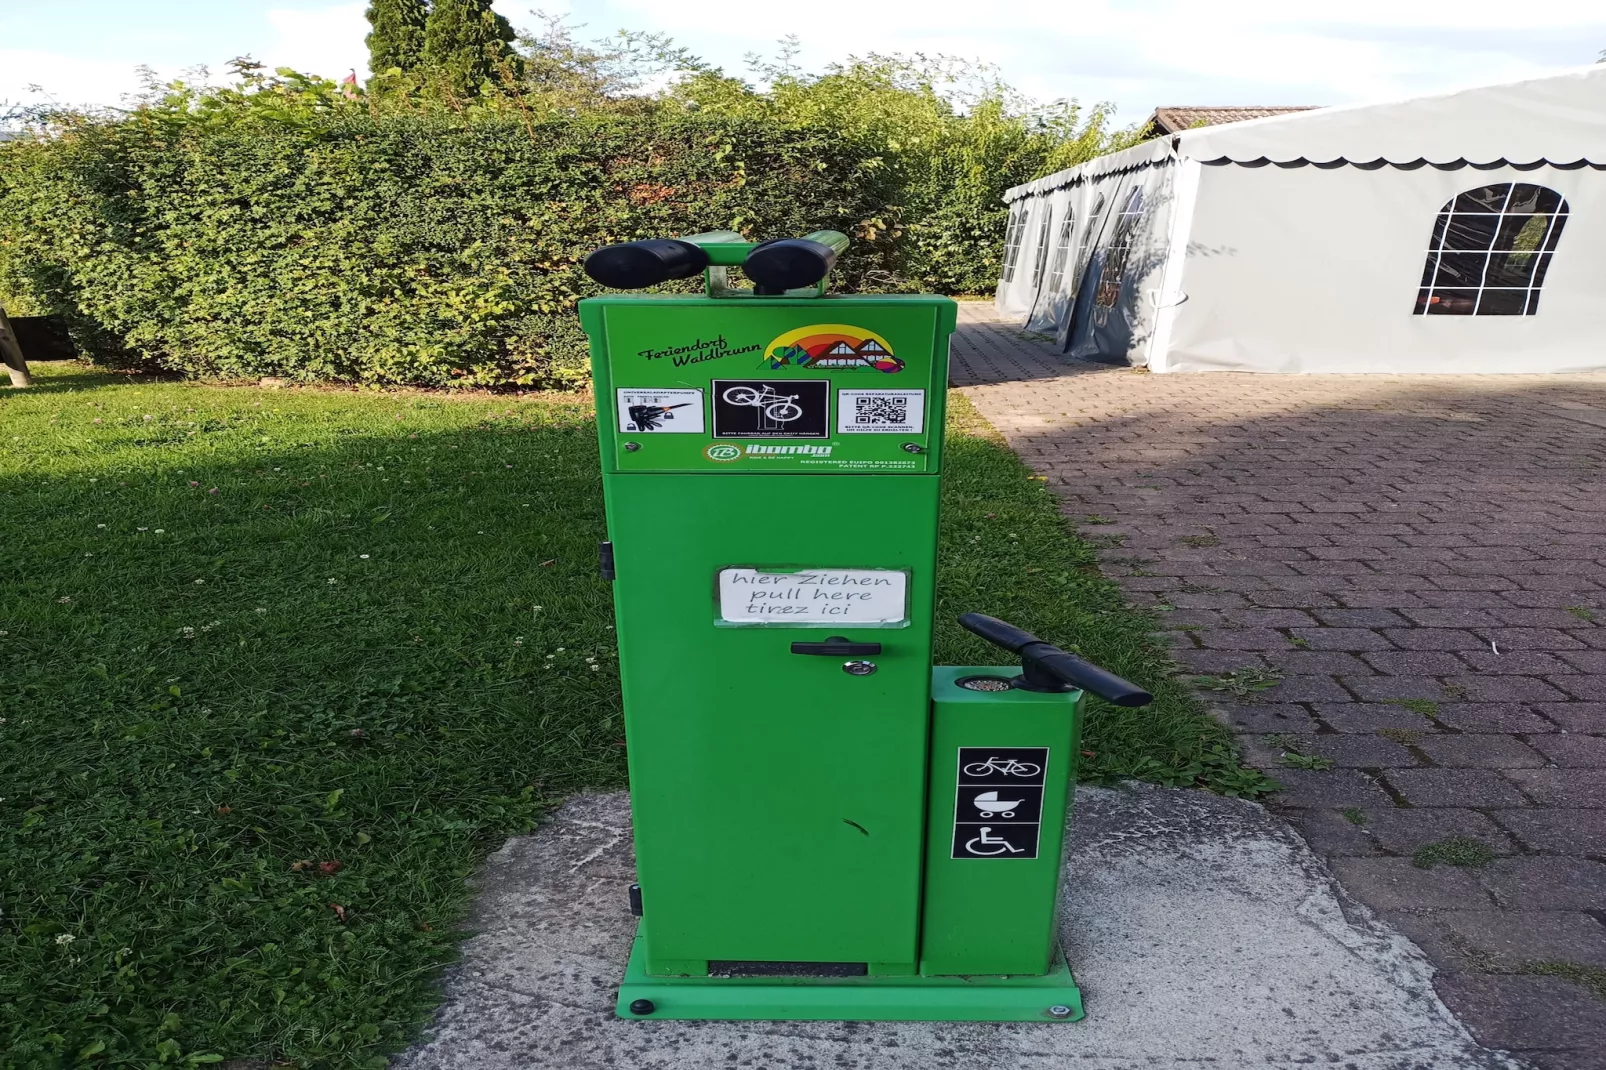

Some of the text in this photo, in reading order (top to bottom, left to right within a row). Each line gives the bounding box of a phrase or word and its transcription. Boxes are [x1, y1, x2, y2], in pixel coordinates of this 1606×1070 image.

[638, 334, 728, 361] Feriendorf
[672, 344, 762, 368] Waldbrunn
[732, 573, 788, 585] hier
[749, 588, 873, 603] pull here
[745, 603, 851, 615] tirez ici
